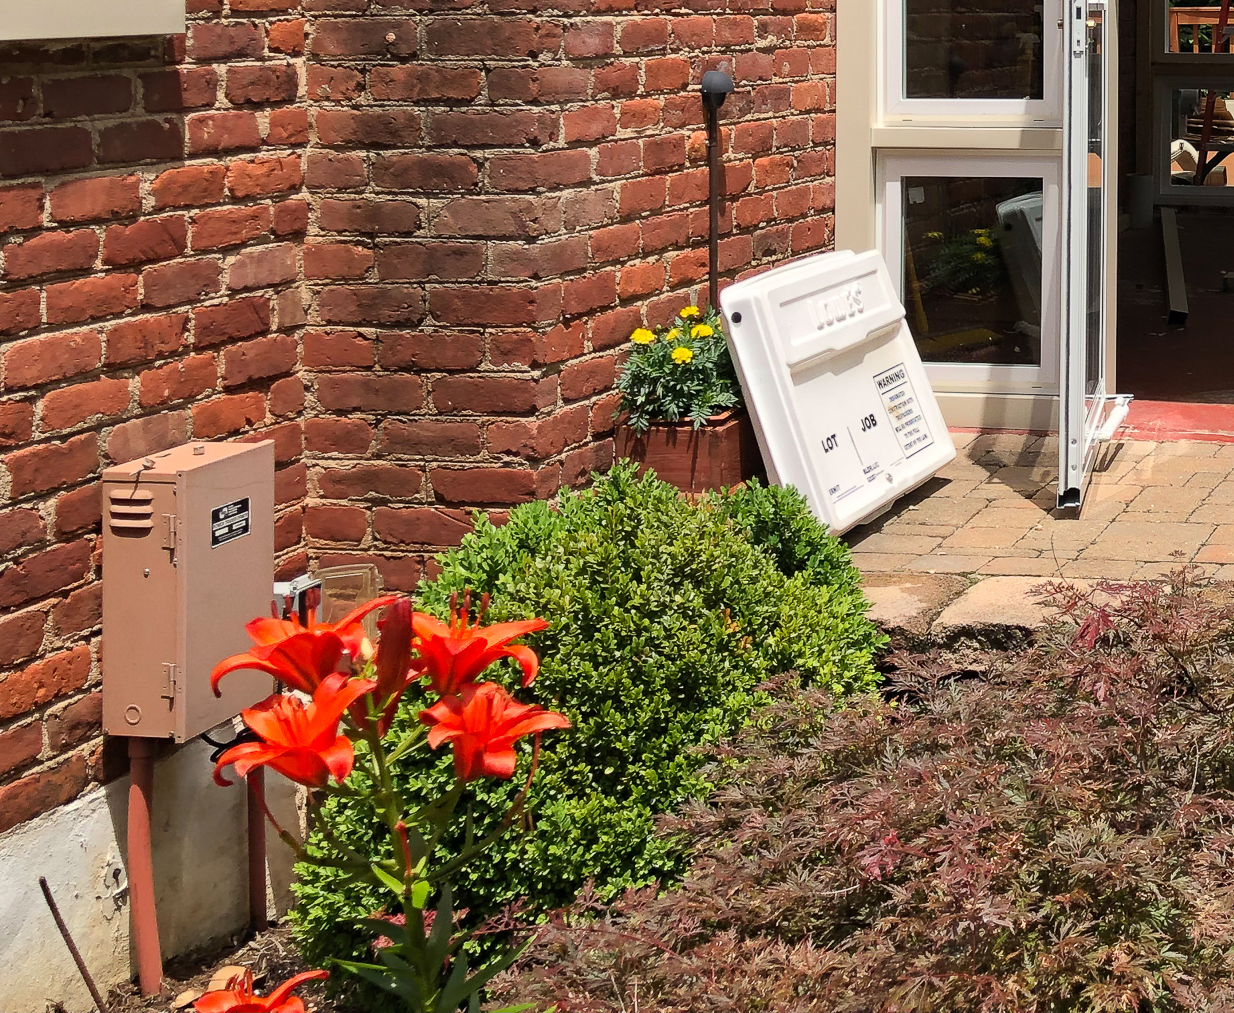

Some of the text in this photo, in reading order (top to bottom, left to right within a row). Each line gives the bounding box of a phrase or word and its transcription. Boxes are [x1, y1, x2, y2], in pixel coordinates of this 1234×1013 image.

[876, 369, 905, 390] WARNING
[860, 413, 877, 432] JOB
[821, 433, 838, 454] LOT
